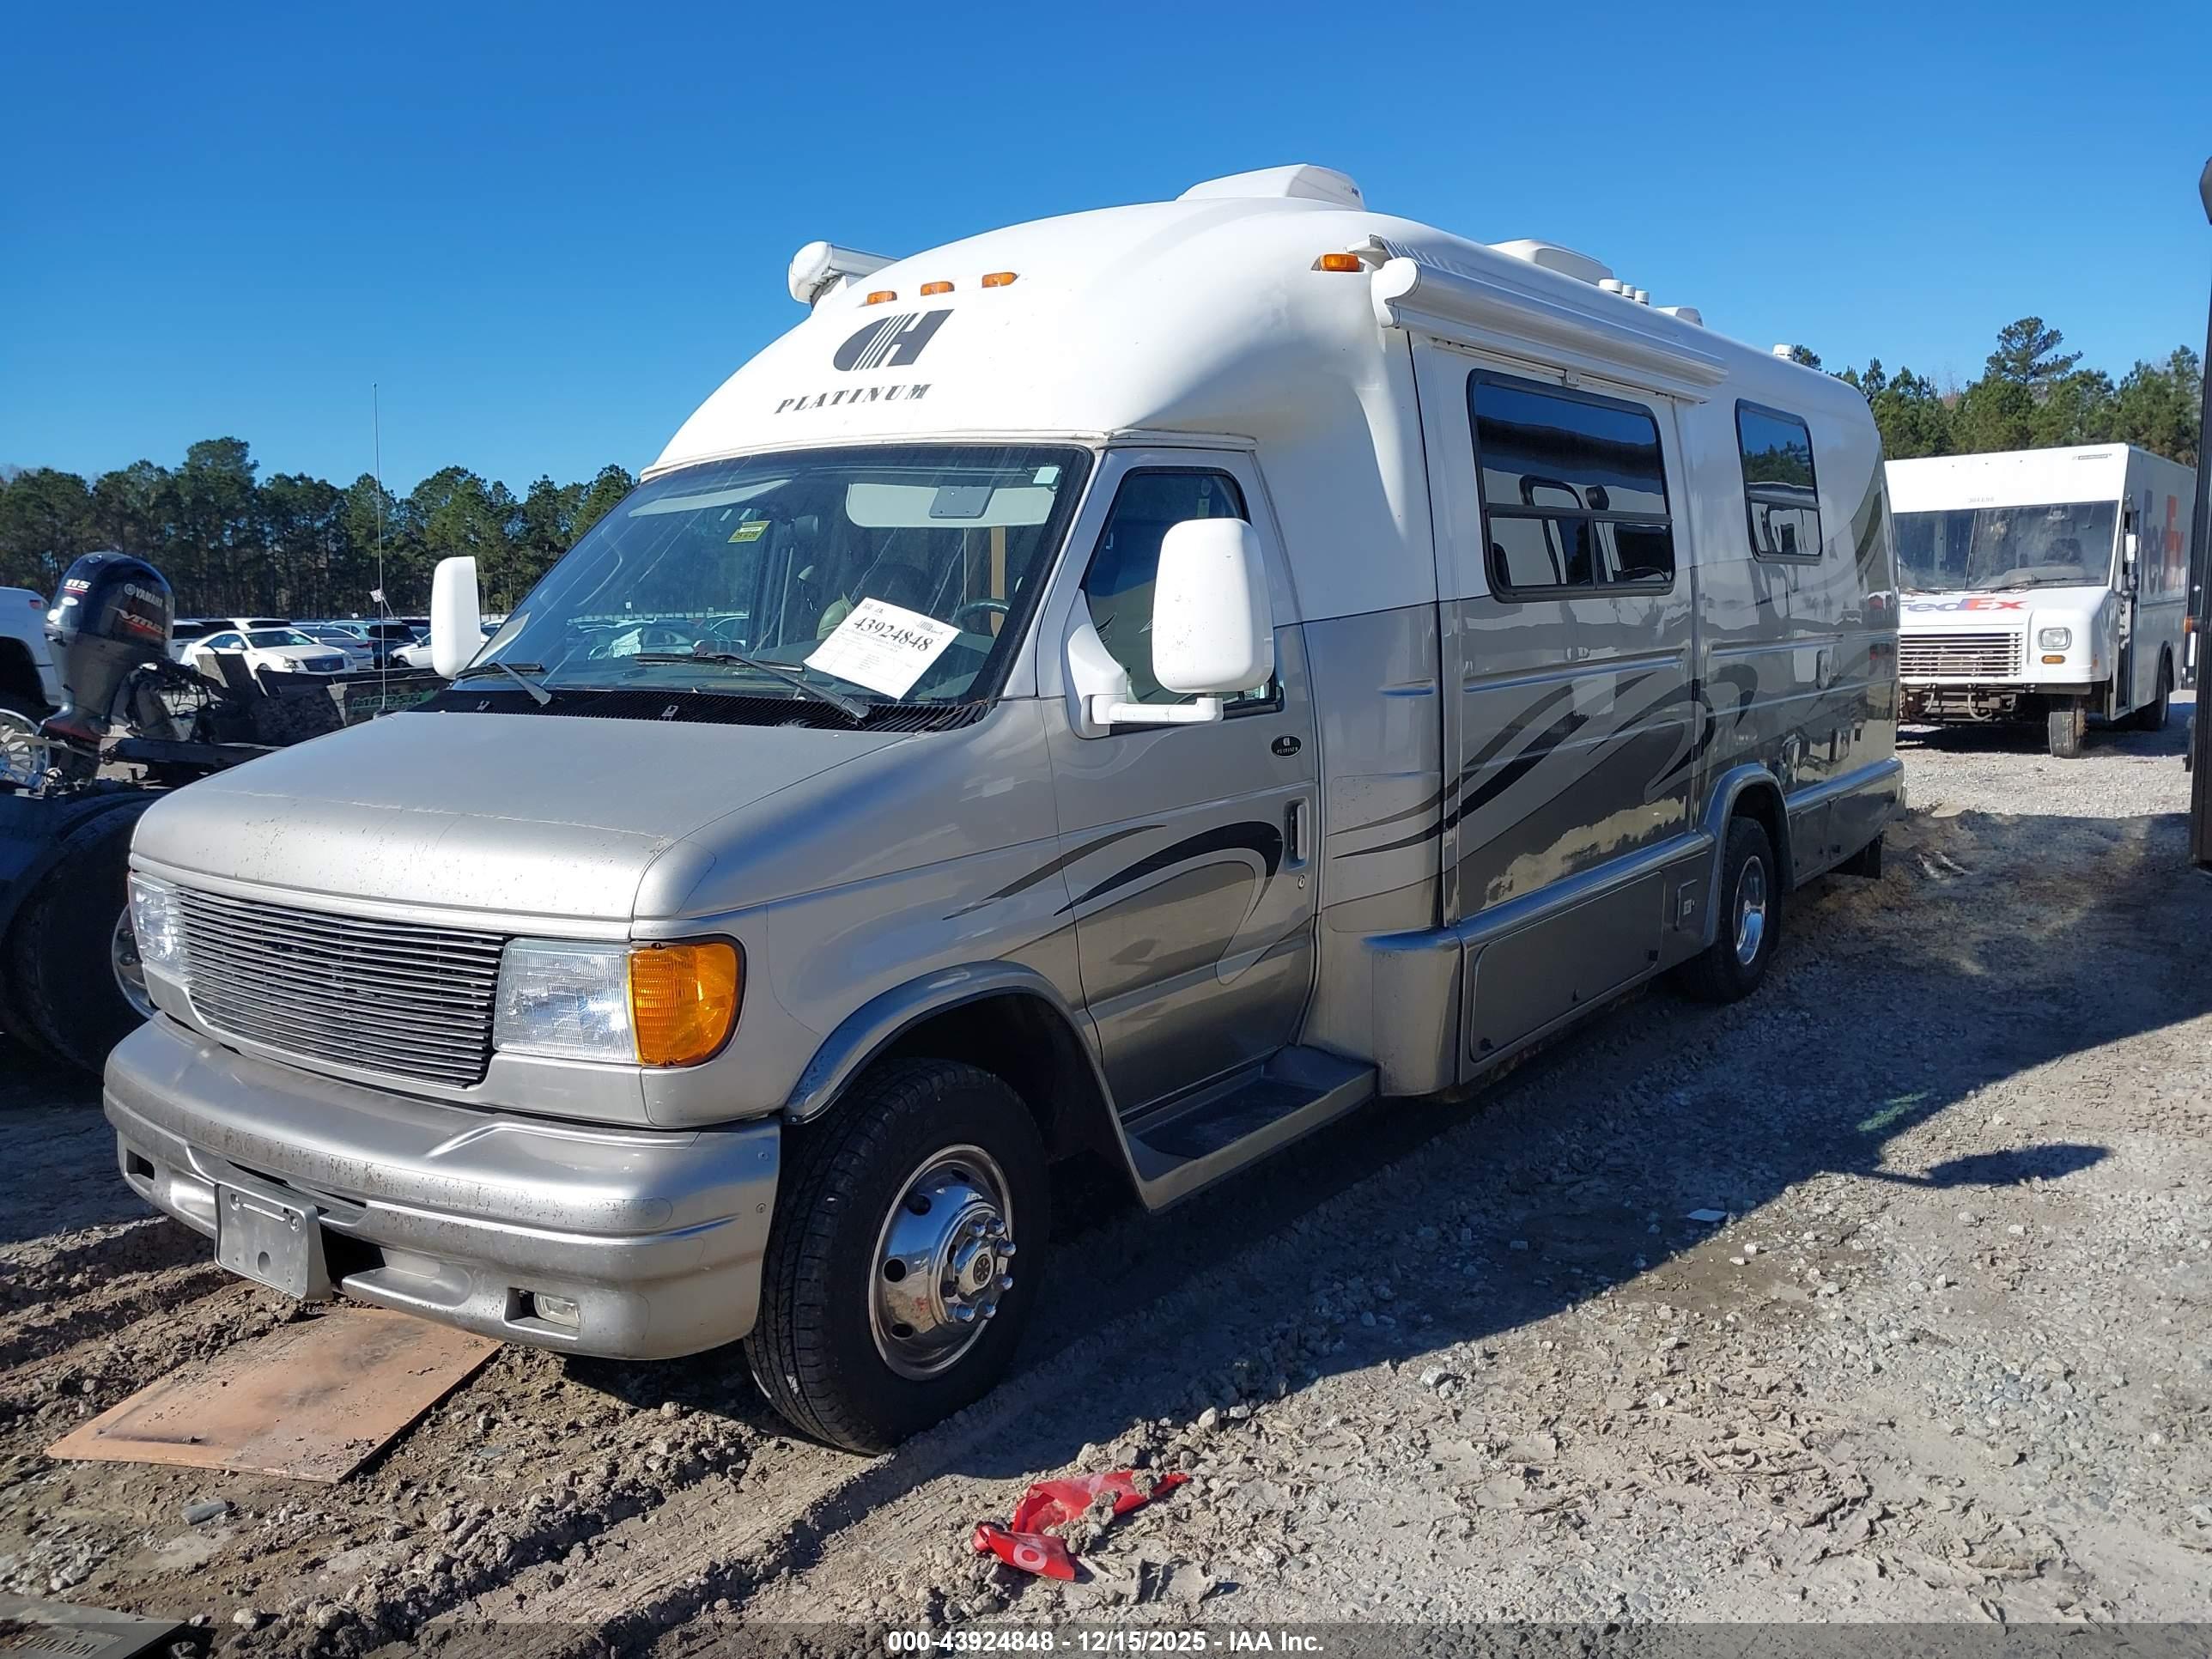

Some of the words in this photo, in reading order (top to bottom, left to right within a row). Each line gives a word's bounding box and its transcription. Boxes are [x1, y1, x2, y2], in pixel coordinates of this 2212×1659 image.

[775, 384, 933, 414] PLATINUM
[66, 579, 91, 589] 115
[136, 586, 163, 608] YAMAHA
[854, 617, 934, 652] 43924848
